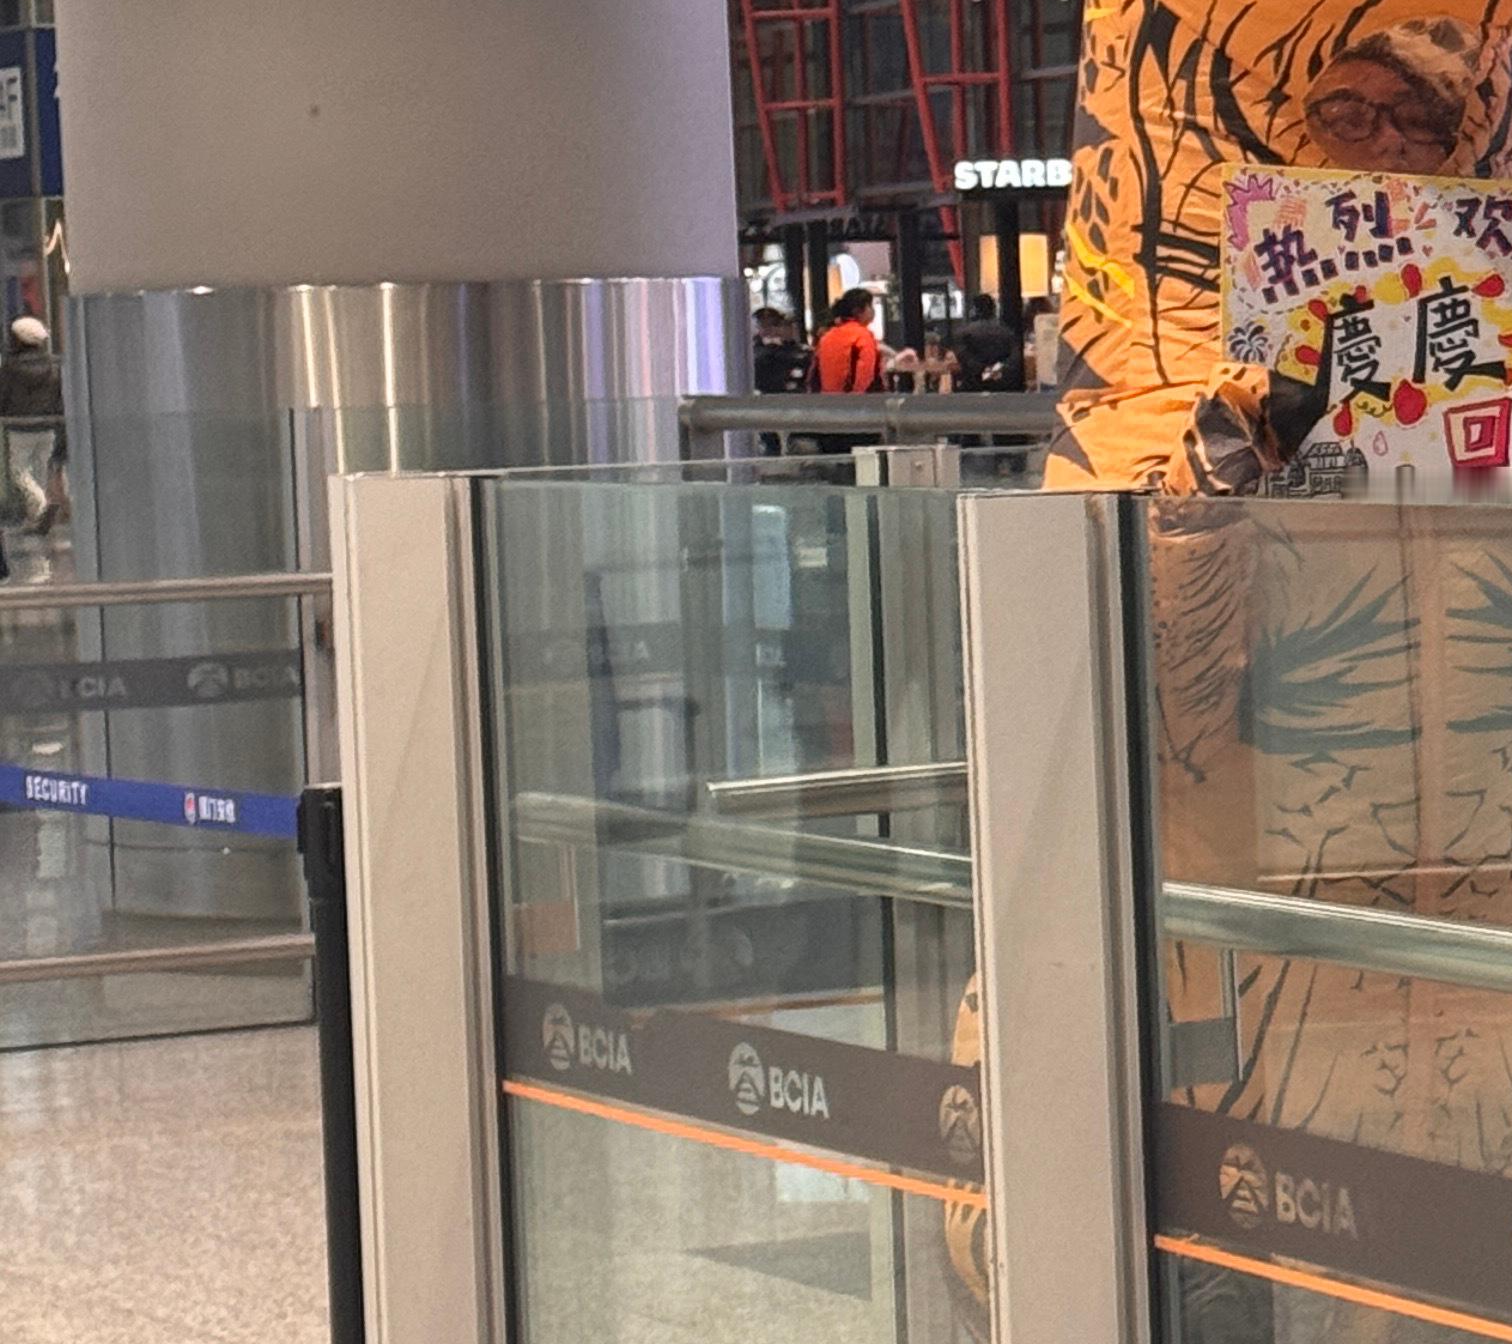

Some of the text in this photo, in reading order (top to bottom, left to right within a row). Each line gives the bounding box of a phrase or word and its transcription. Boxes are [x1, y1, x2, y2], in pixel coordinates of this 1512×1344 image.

[954, 158, 1073, 191] STARB
[25, 775, 88, 806] SECURITY
[578, 1023, 633, 1076] BCIA
[768, 1065, 830, 1120] BCIA
[1273, 1172, 1360, 1242] BCIA
